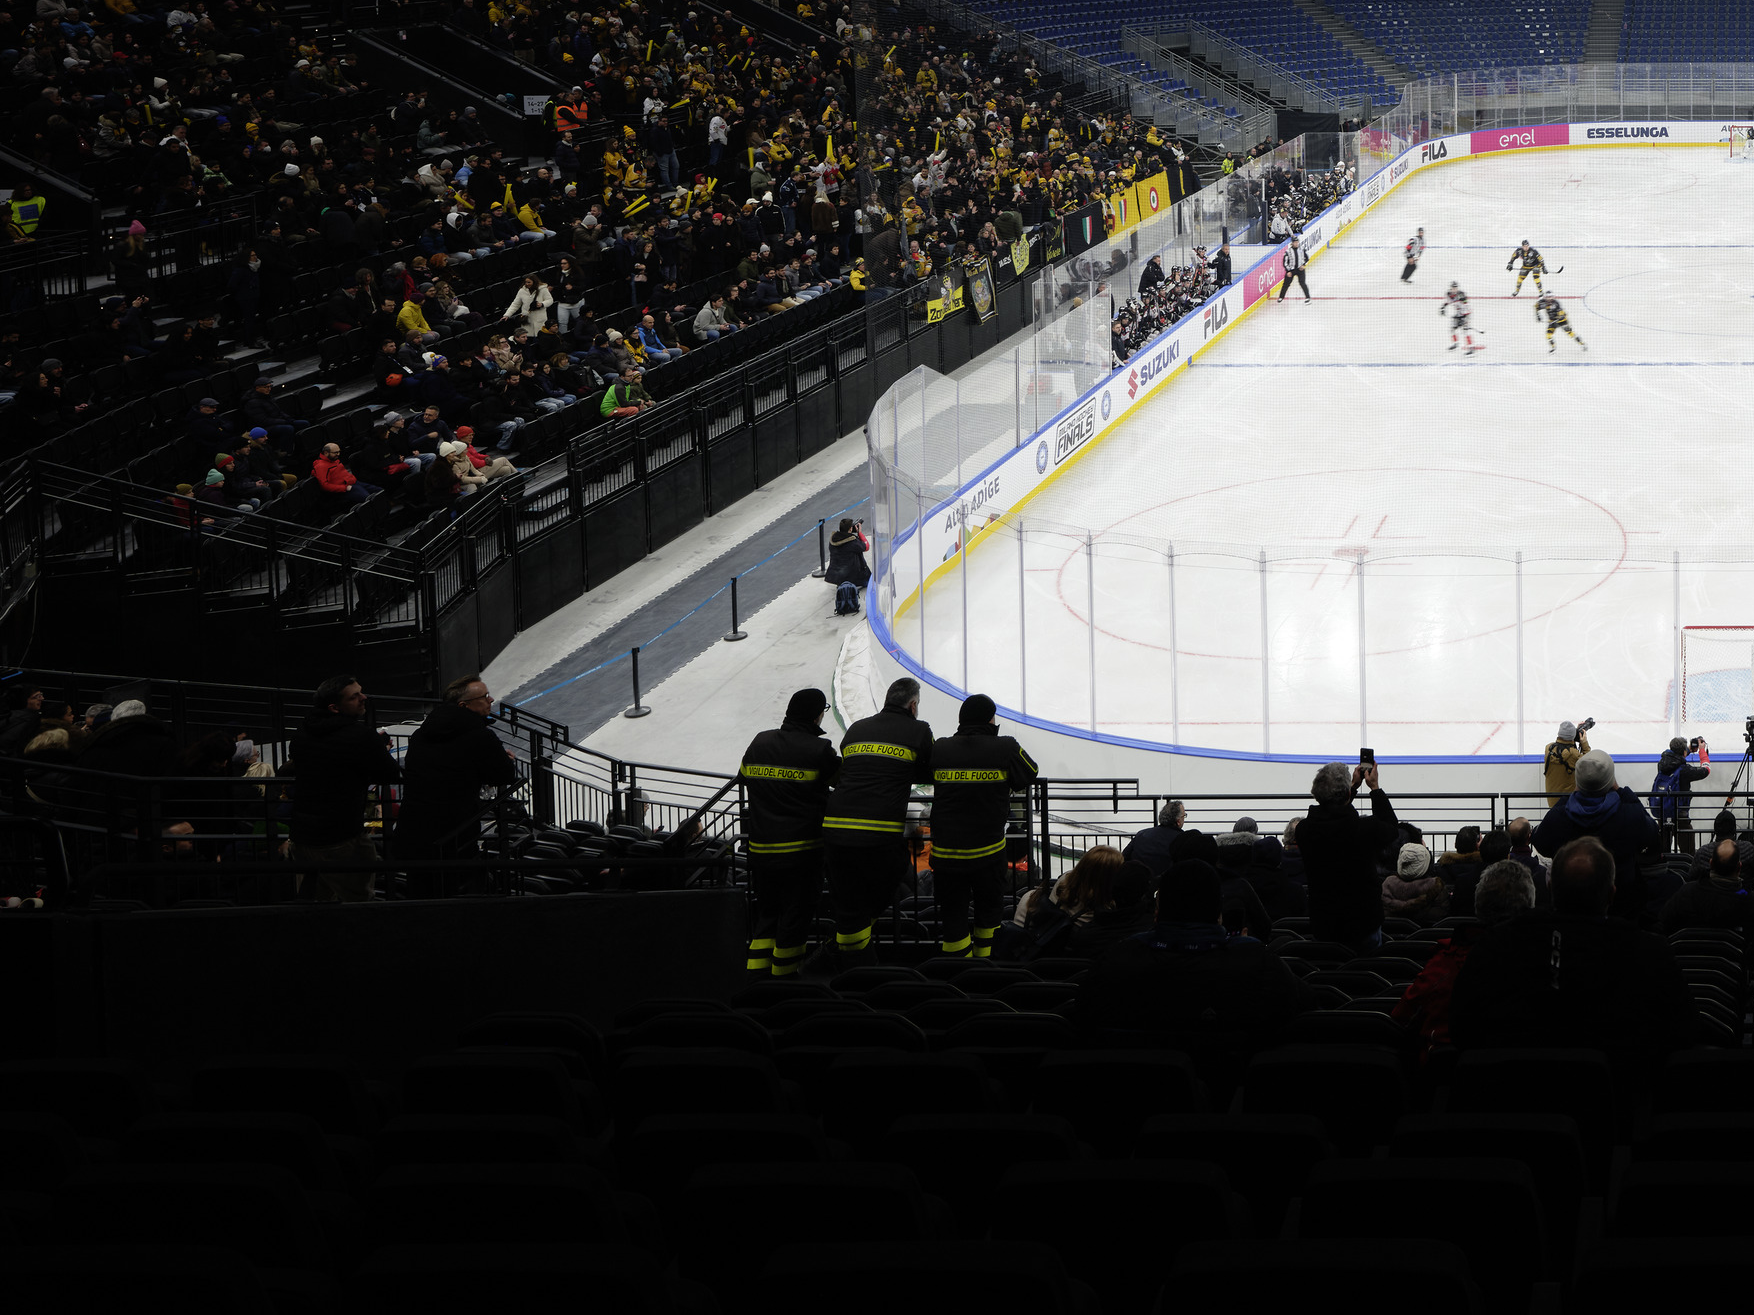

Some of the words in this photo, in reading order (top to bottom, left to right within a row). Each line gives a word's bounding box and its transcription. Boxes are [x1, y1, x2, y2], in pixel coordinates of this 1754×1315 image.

[1499, 129, 1536, 148] enel
[1586, 126, 1669, 139] ESSELUNGA
[1421, 141, 1448, 164] FILA
[1258, 258, 1276, 294] enel
[1203, 298, 1228, 340] FILA
[1140, 339, 1180, 386] SUZUKI
[1057, 413, 1093, 458] FINALS
[1058, 420, 1076, 437] MILANO
[861, 744, 875, 753] DEL
[876, 745, 905, 757] FUOCO
[749, 767, 765, 776] VIGILI
[764, 768, 776, 777] DEL
[777, 769, 805, 779] FUOCO
[954, 771, 969, 780] DEL
[971, 771, 999, 780] FUOCO
